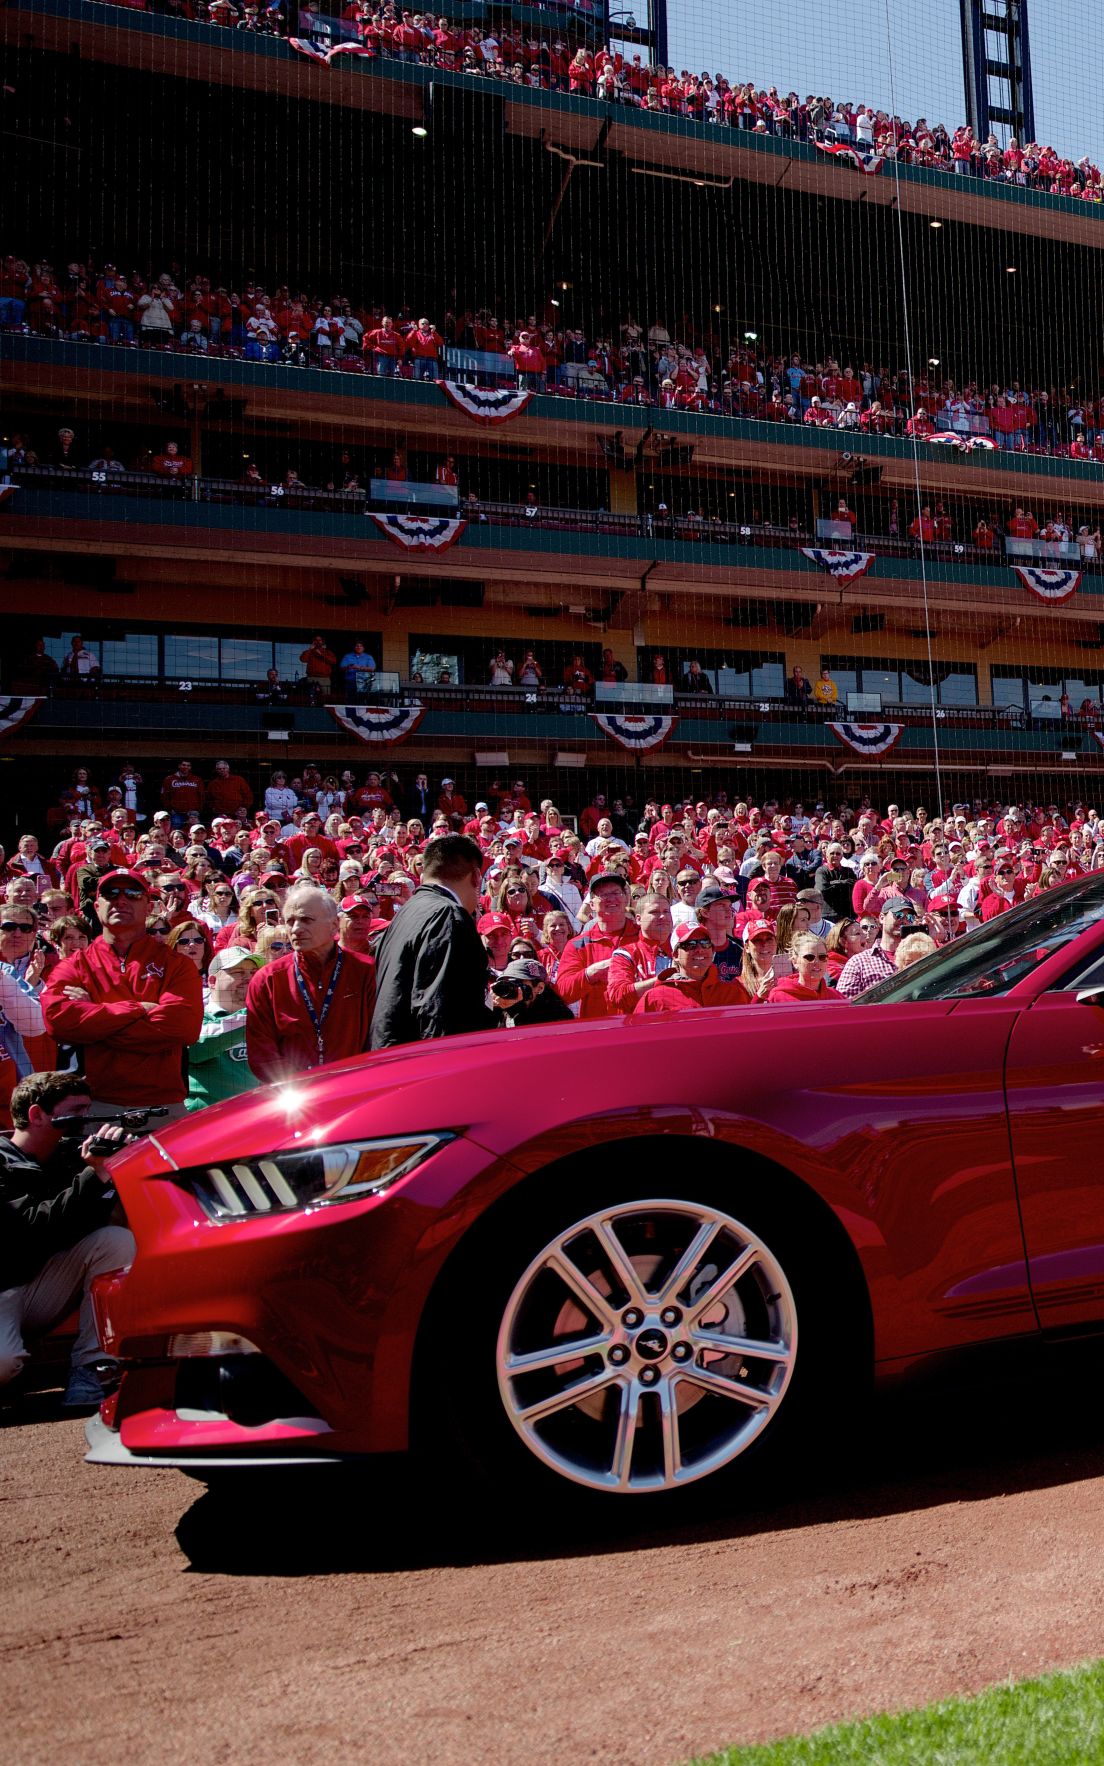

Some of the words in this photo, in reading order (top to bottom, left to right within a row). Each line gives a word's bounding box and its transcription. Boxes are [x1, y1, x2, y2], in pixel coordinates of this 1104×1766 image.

[92, 472, 106, 481] 55
[271, 486, 285, 496] 56
[525, 507, 538, 517] 57
[740, 526, 751, 535] 58
[954, 545, 964, 553] 59
[179, 681, 192, 691] 23
[525, 693, 537, 702] 24
[759, 702, 770, 711] 25
[936, 709, 946, 718] 26
